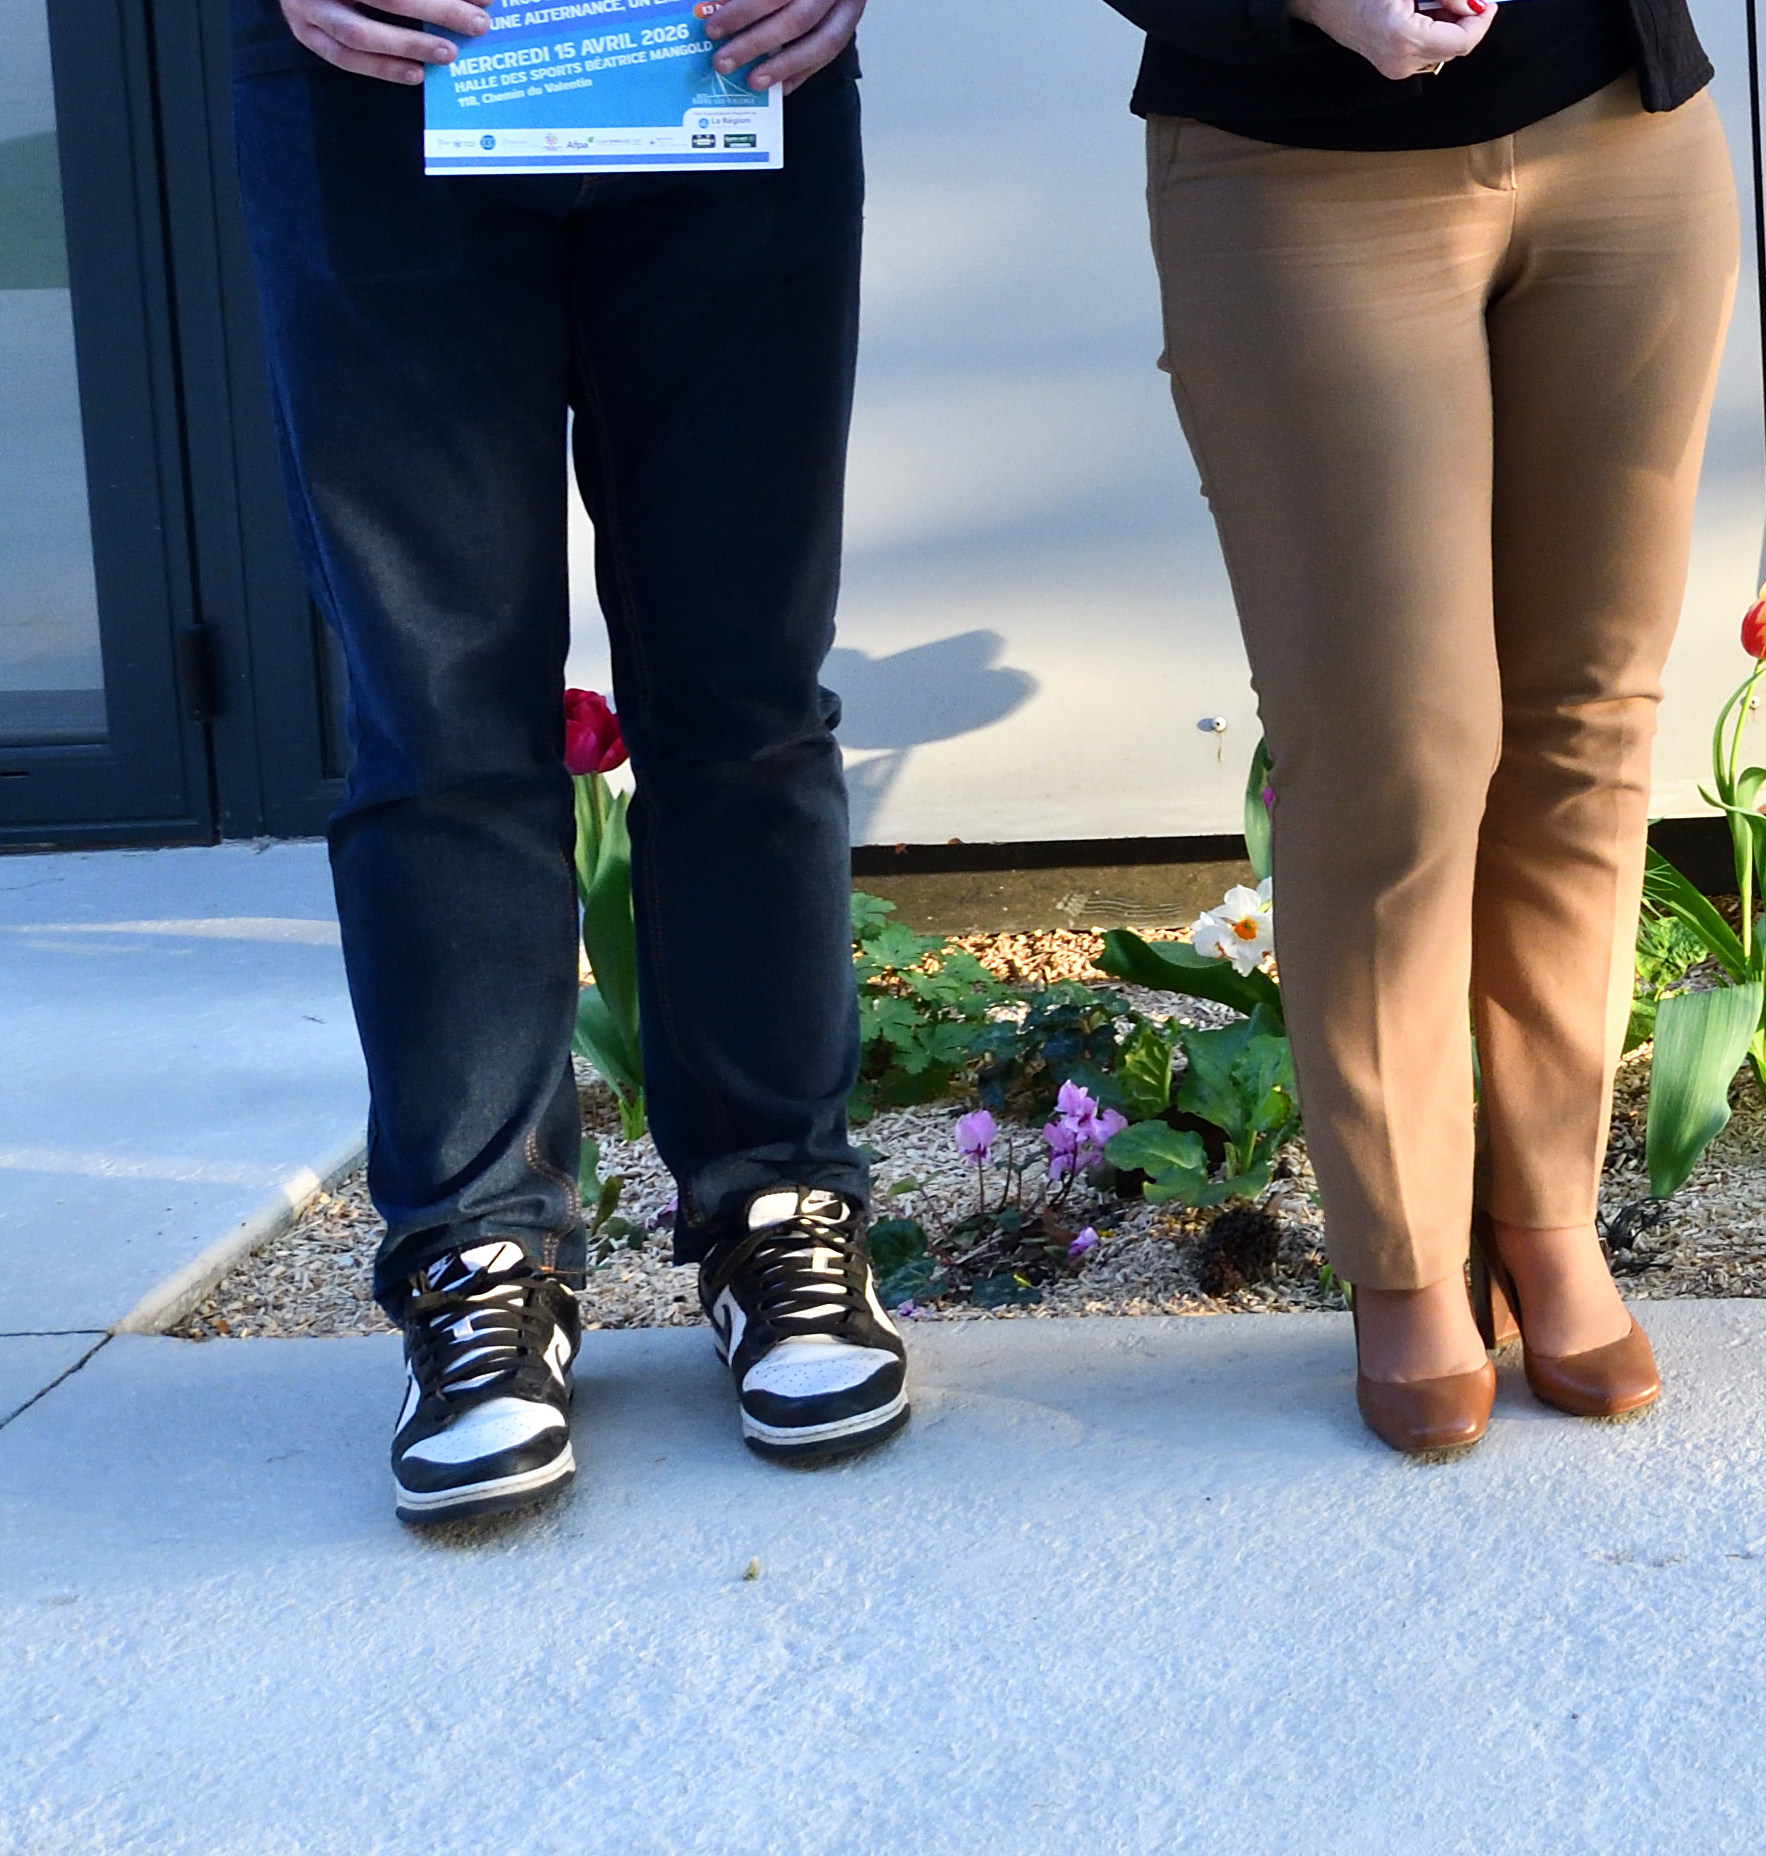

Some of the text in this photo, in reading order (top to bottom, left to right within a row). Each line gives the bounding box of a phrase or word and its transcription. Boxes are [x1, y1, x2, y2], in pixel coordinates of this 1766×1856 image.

[448, 23, 690, 78] MERCREDI 15 AVRIL 2026
